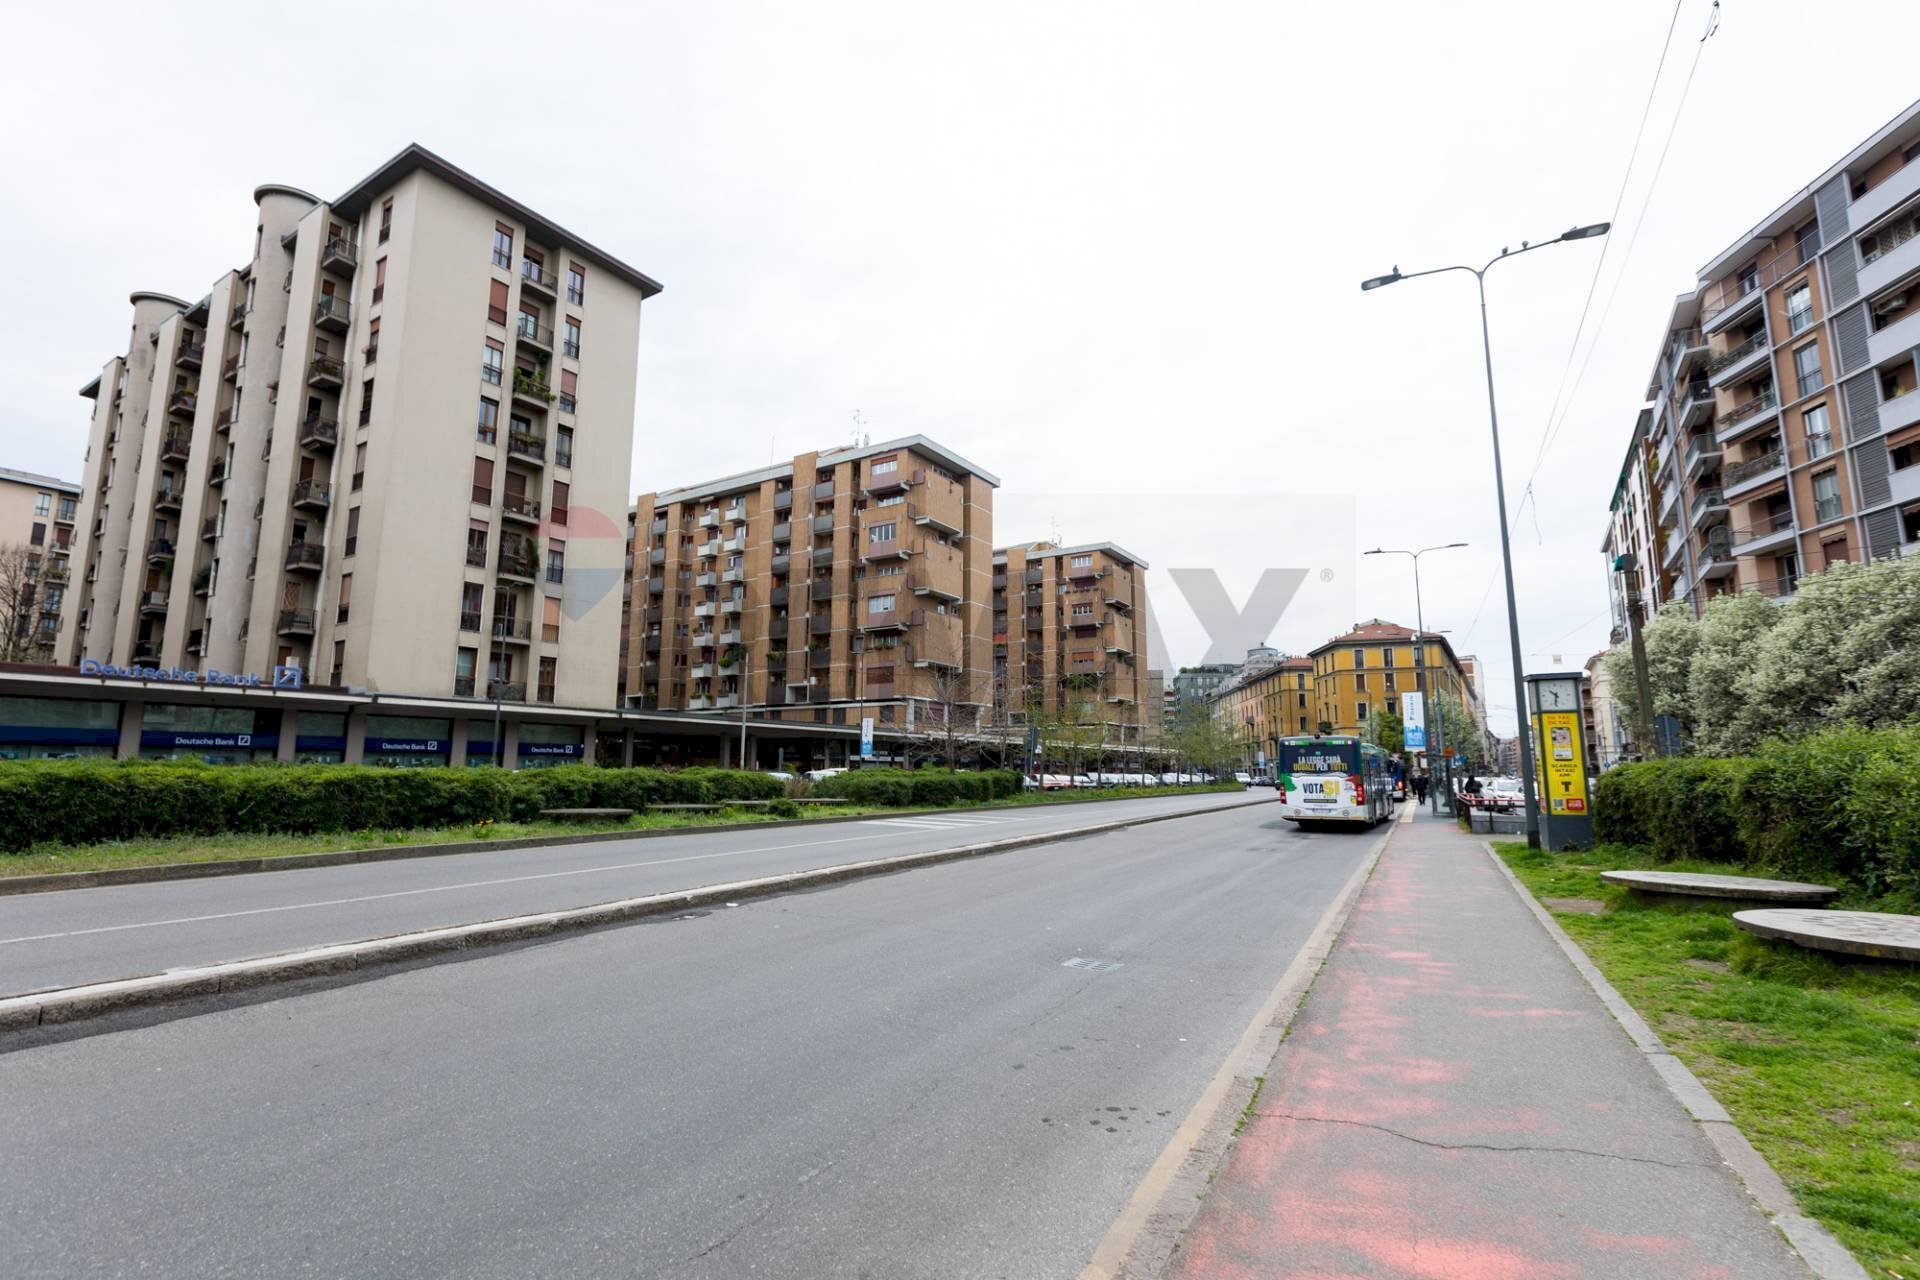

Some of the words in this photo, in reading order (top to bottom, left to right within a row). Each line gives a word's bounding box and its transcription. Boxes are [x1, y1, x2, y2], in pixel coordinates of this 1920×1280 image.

[80, 658, 198, 681] Deutsche
[205, 669, 262, 686] Bank
[175, 736, 214, 745] Deutsche
[382, 742, 411, 750] Deutsche
[1303, 783, 1324, 794] VOTA
